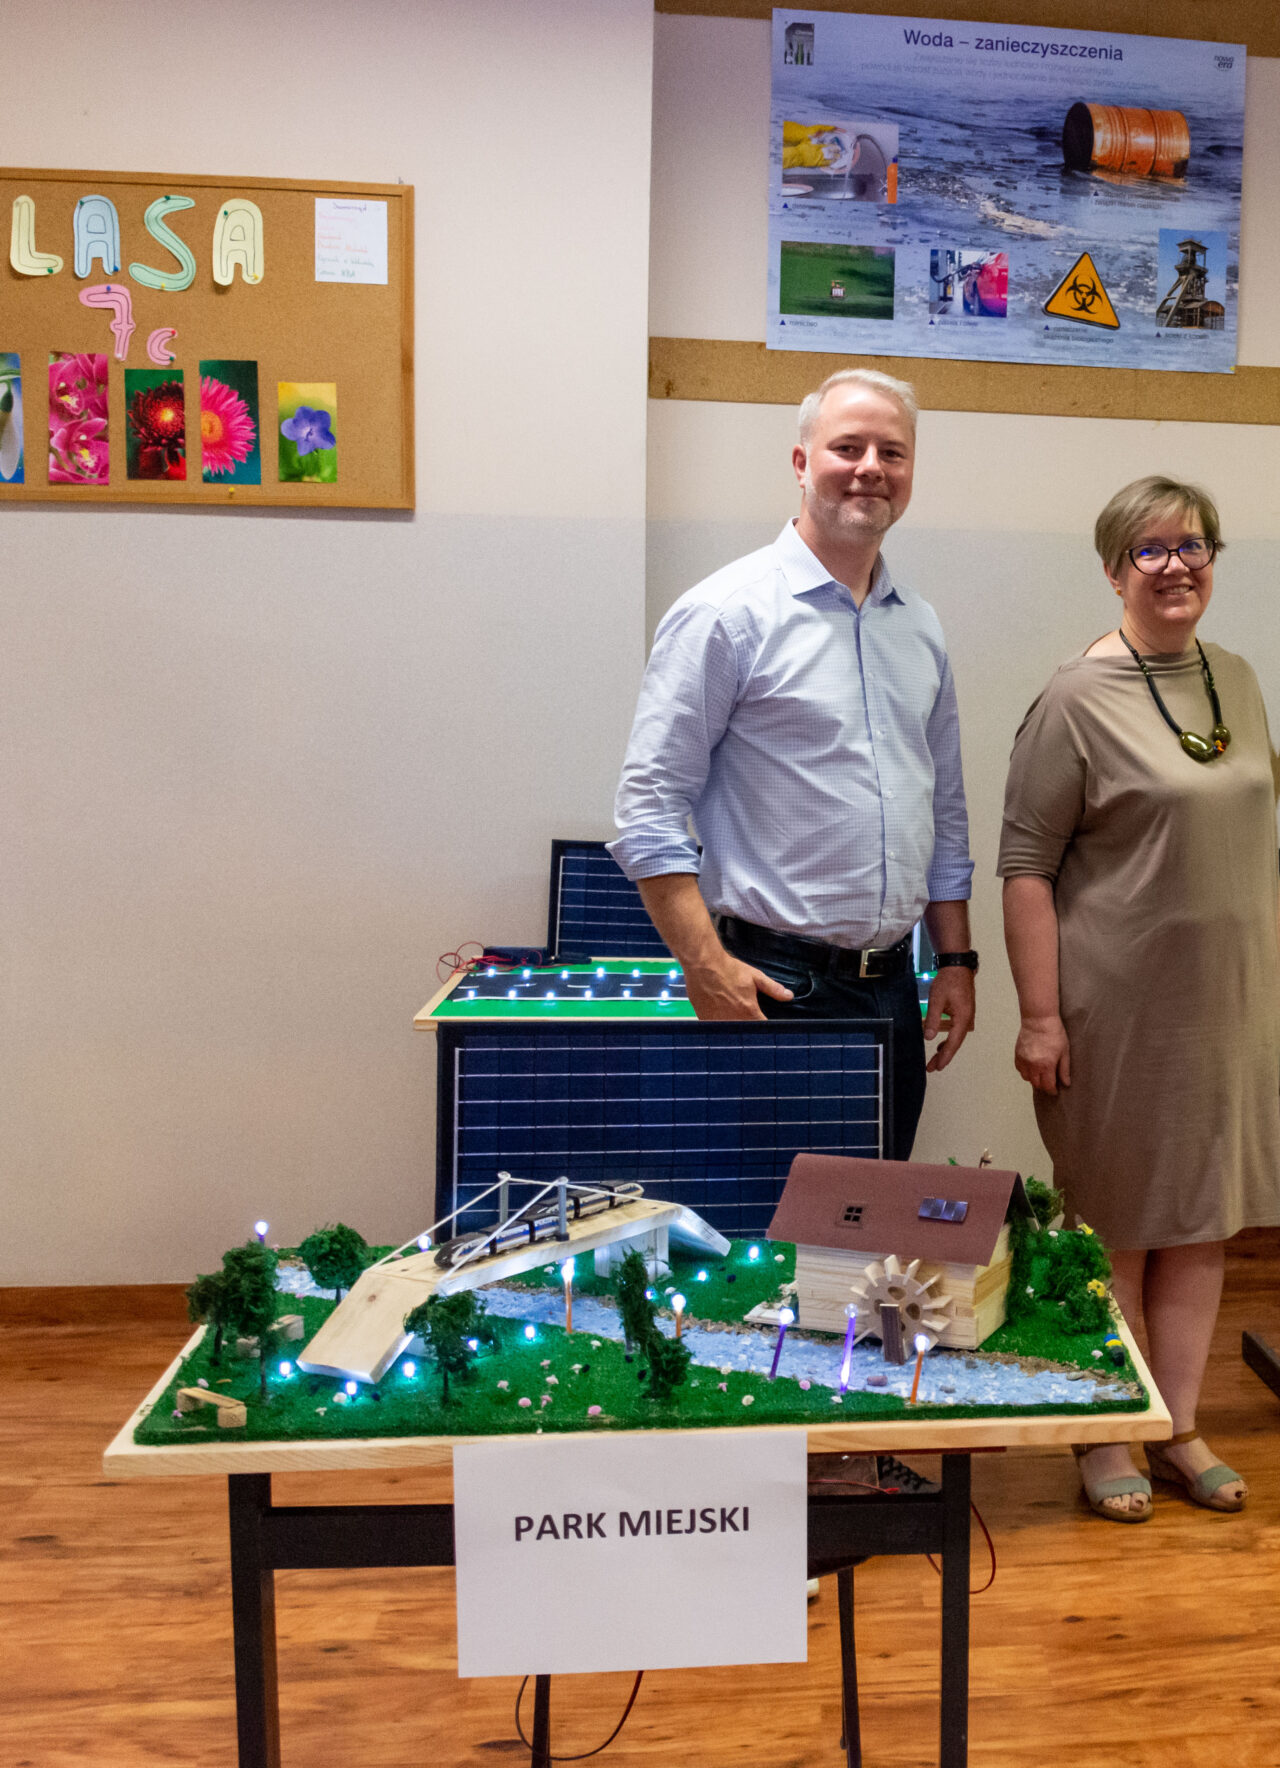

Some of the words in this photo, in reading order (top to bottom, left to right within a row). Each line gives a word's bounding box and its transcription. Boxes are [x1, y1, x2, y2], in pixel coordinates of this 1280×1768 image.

[903, 29, 954, 48] Woda
[974, 36, 1123, 61] zanieczyszczenia
[514, 1512, 607, 1542] PARK
[618, 1506, 750, 1537] MIEJSKI
